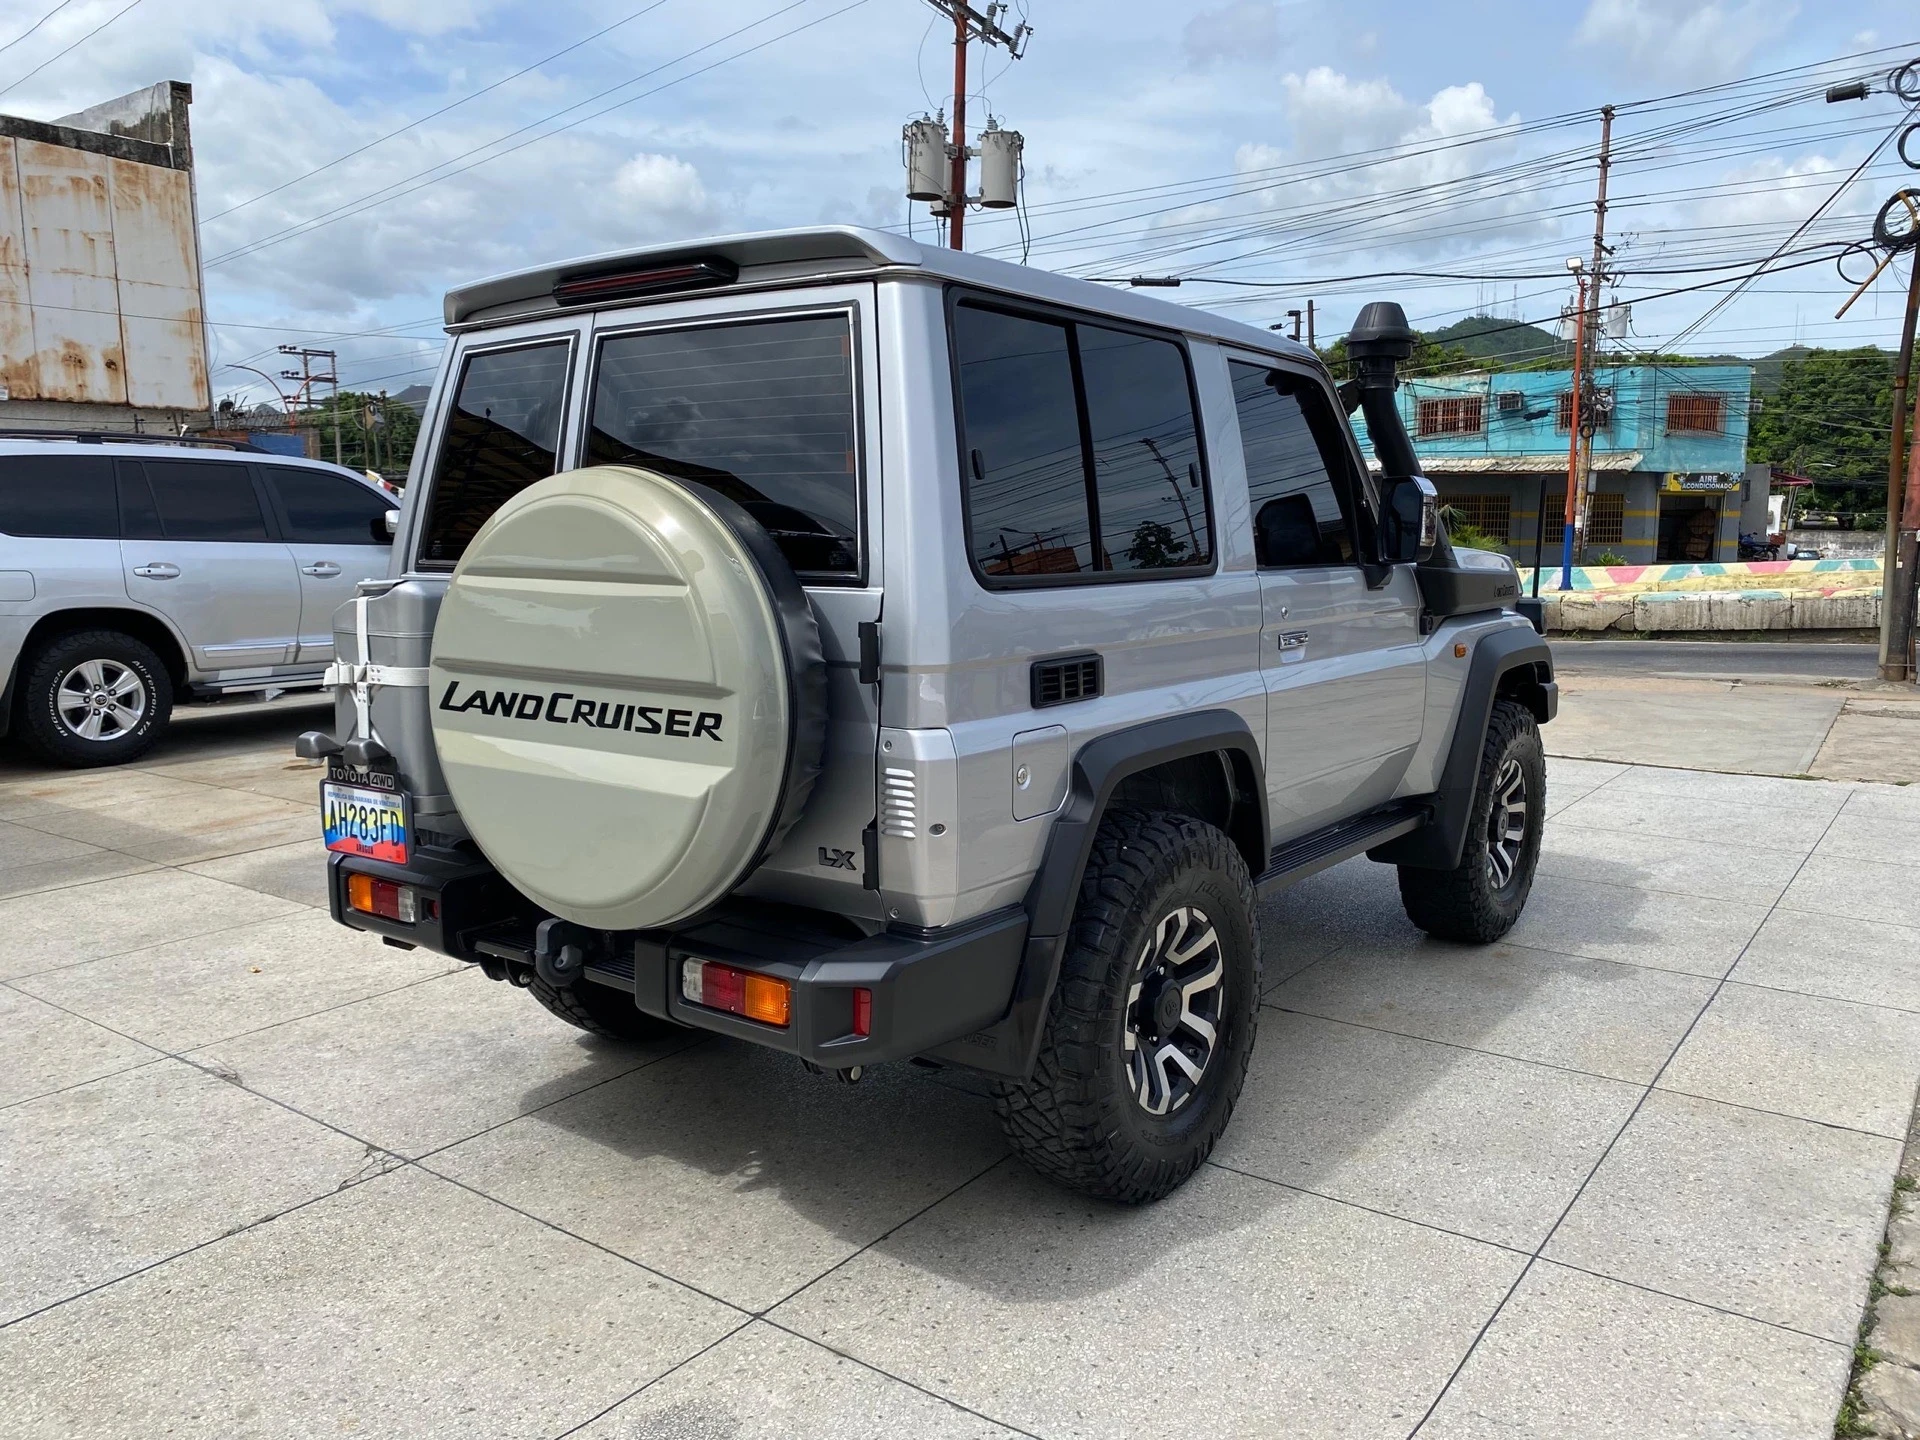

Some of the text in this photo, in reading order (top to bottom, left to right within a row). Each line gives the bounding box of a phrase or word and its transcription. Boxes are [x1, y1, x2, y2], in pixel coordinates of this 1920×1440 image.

[1699, 475, 1718, 483] AIRE
[331, 767, 394, 788] TOYOTA 4WD
[329, 800, 400, 847] AH283FD
[818, 847, 857, 871] LX
